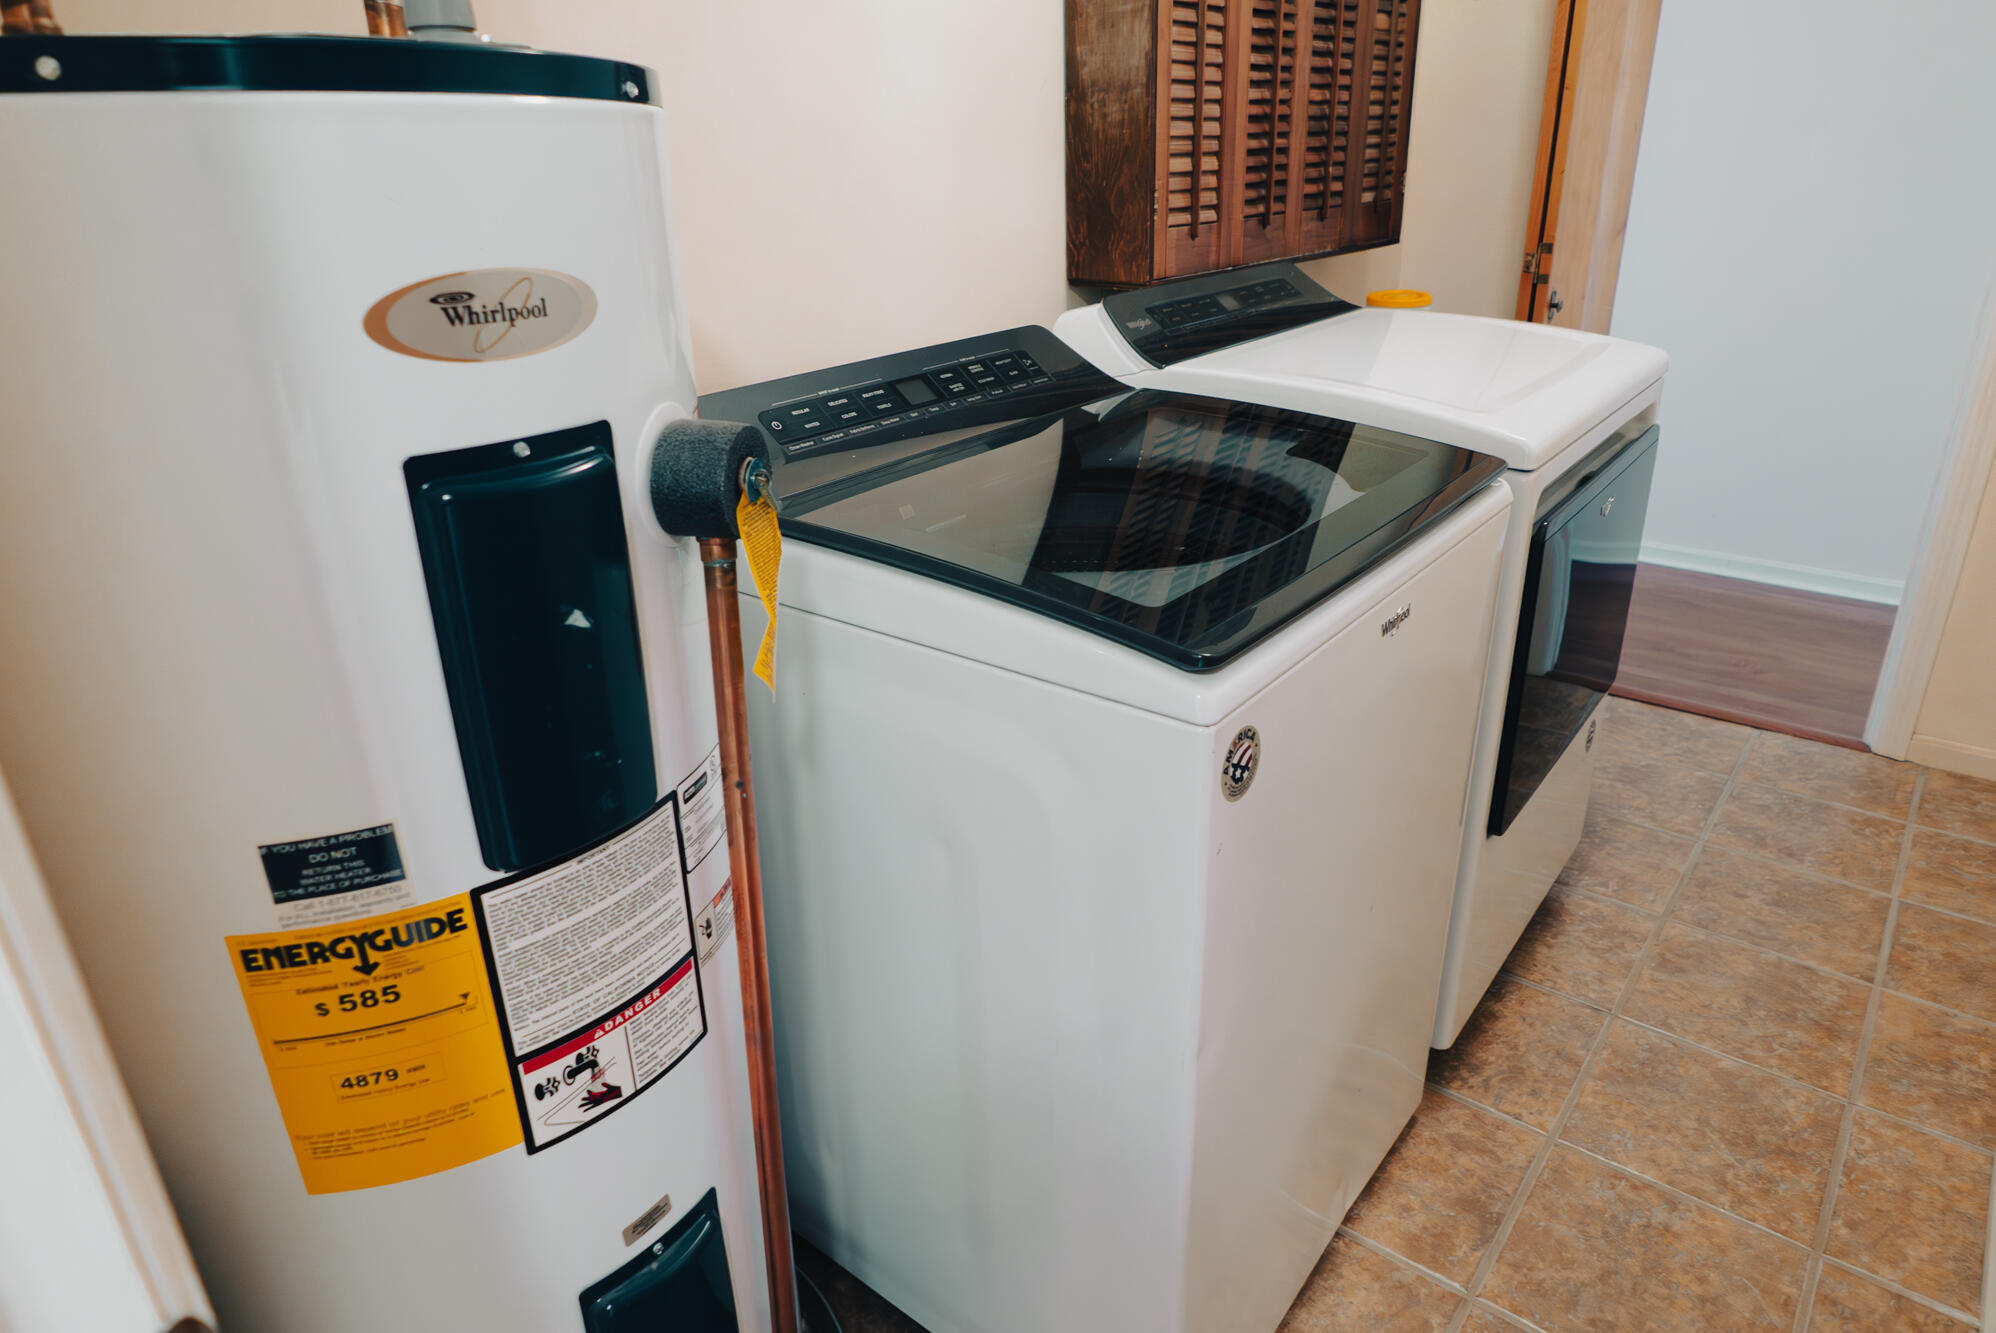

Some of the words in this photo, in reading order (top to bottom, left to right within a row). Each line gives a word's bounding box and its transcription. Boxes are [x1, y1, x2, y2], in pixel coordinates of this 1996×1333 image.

[441, 297, 548, 328] Whirlpool
[273, 843, 297, 854] YOU
[328, 836, 338, 846] A
[308, 852, 329, 864] DO
[331, 846, 358, 859] NOT
[301, 864, 342, 876] RETURN
[334, 867, 372, 880] HEATER
[240, 908, 468, 975] ENERGYGUIDE
[338, 984, 401, 1013] 585
[603, 987, 662, 1033] DANGER
[340, 1067, 399, 1090] 4879
